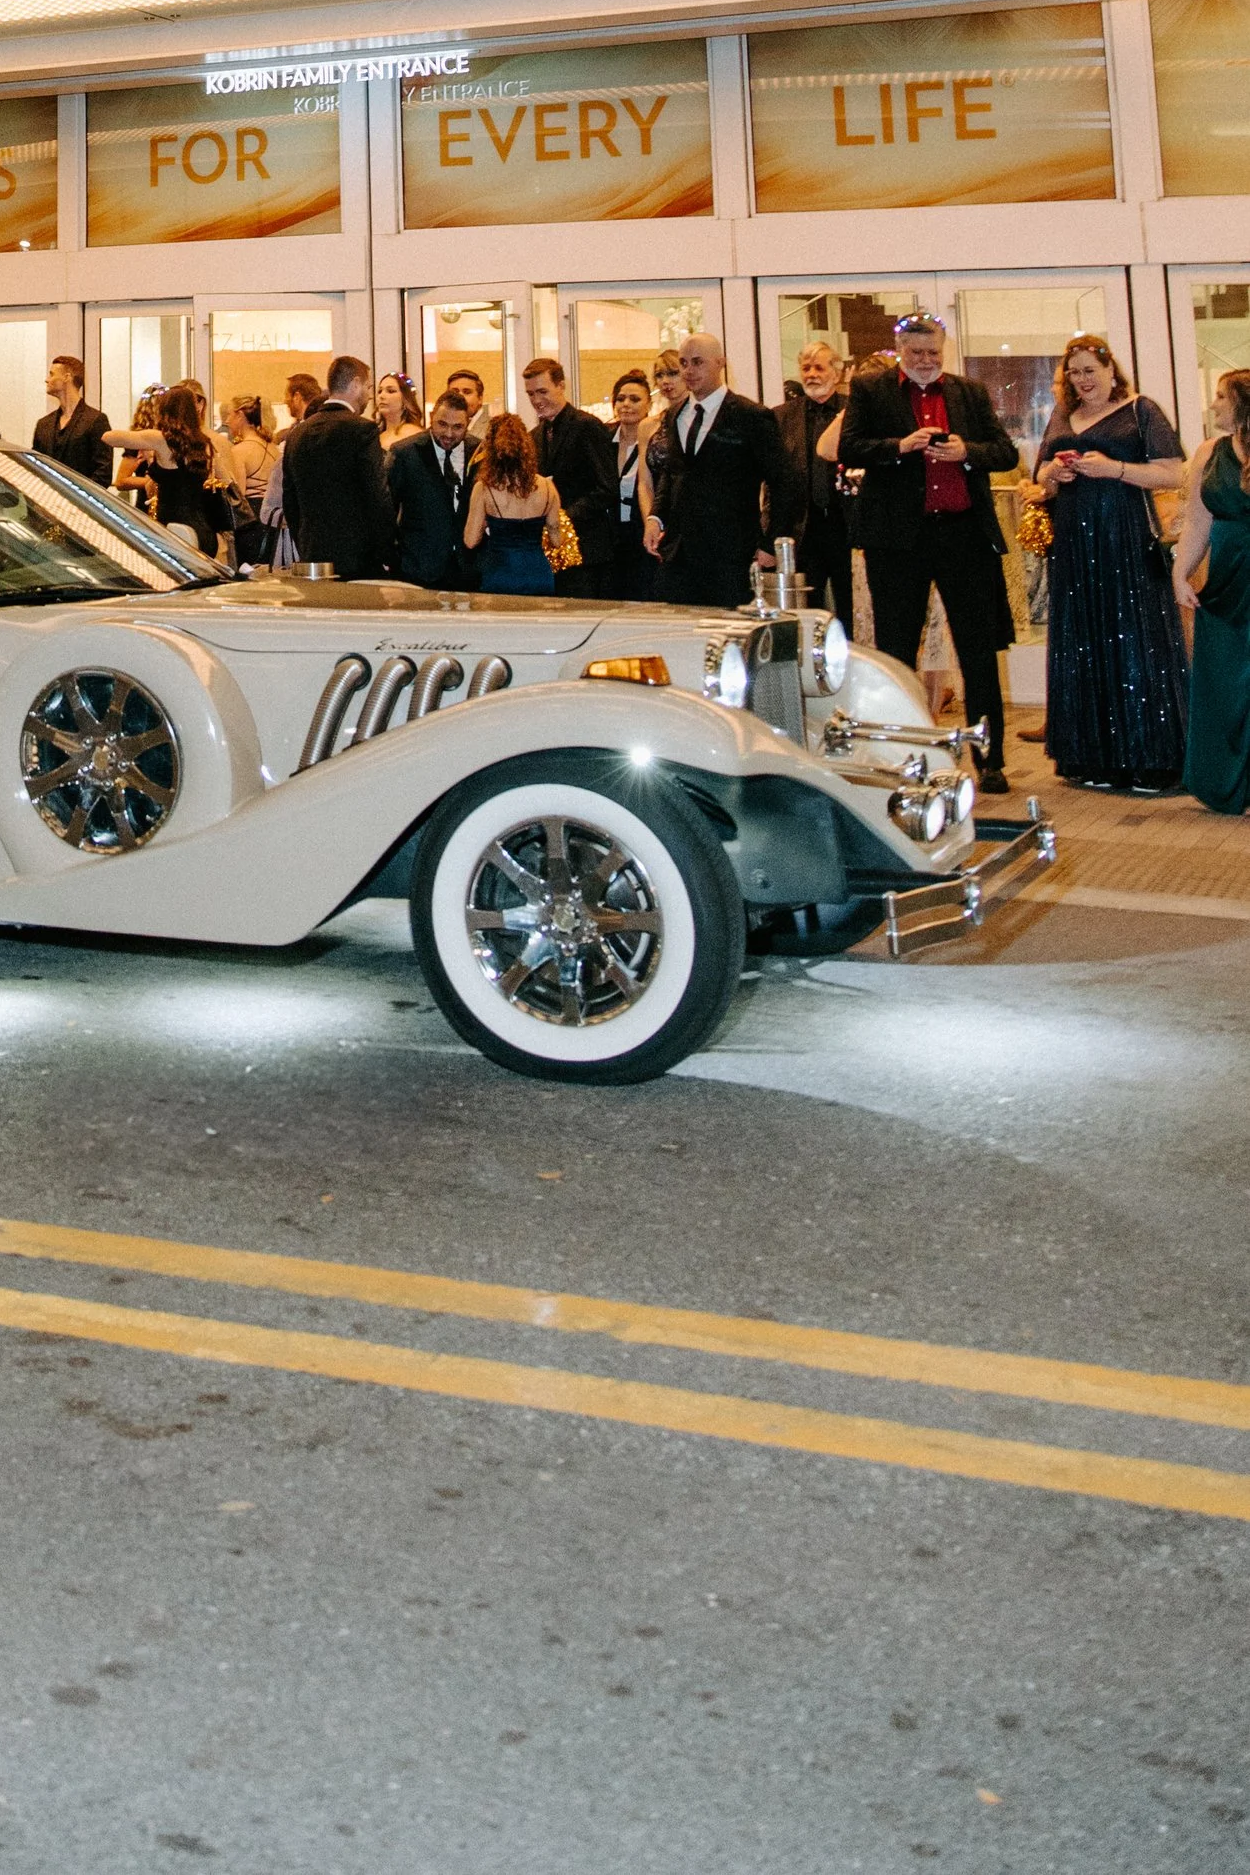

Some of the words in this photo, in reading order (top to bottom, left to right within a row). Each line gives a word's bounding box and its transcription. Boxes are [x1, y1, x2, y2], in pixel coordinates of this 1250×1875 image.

[205, 69, 278, 95] KOBRIN
[281, 62, 352, 89] FAMILY
[355, 51, 470, 83] ENTRANCE
[148, 126, 272, 189] FOR
[437, 94, 667, 169] EVERY
